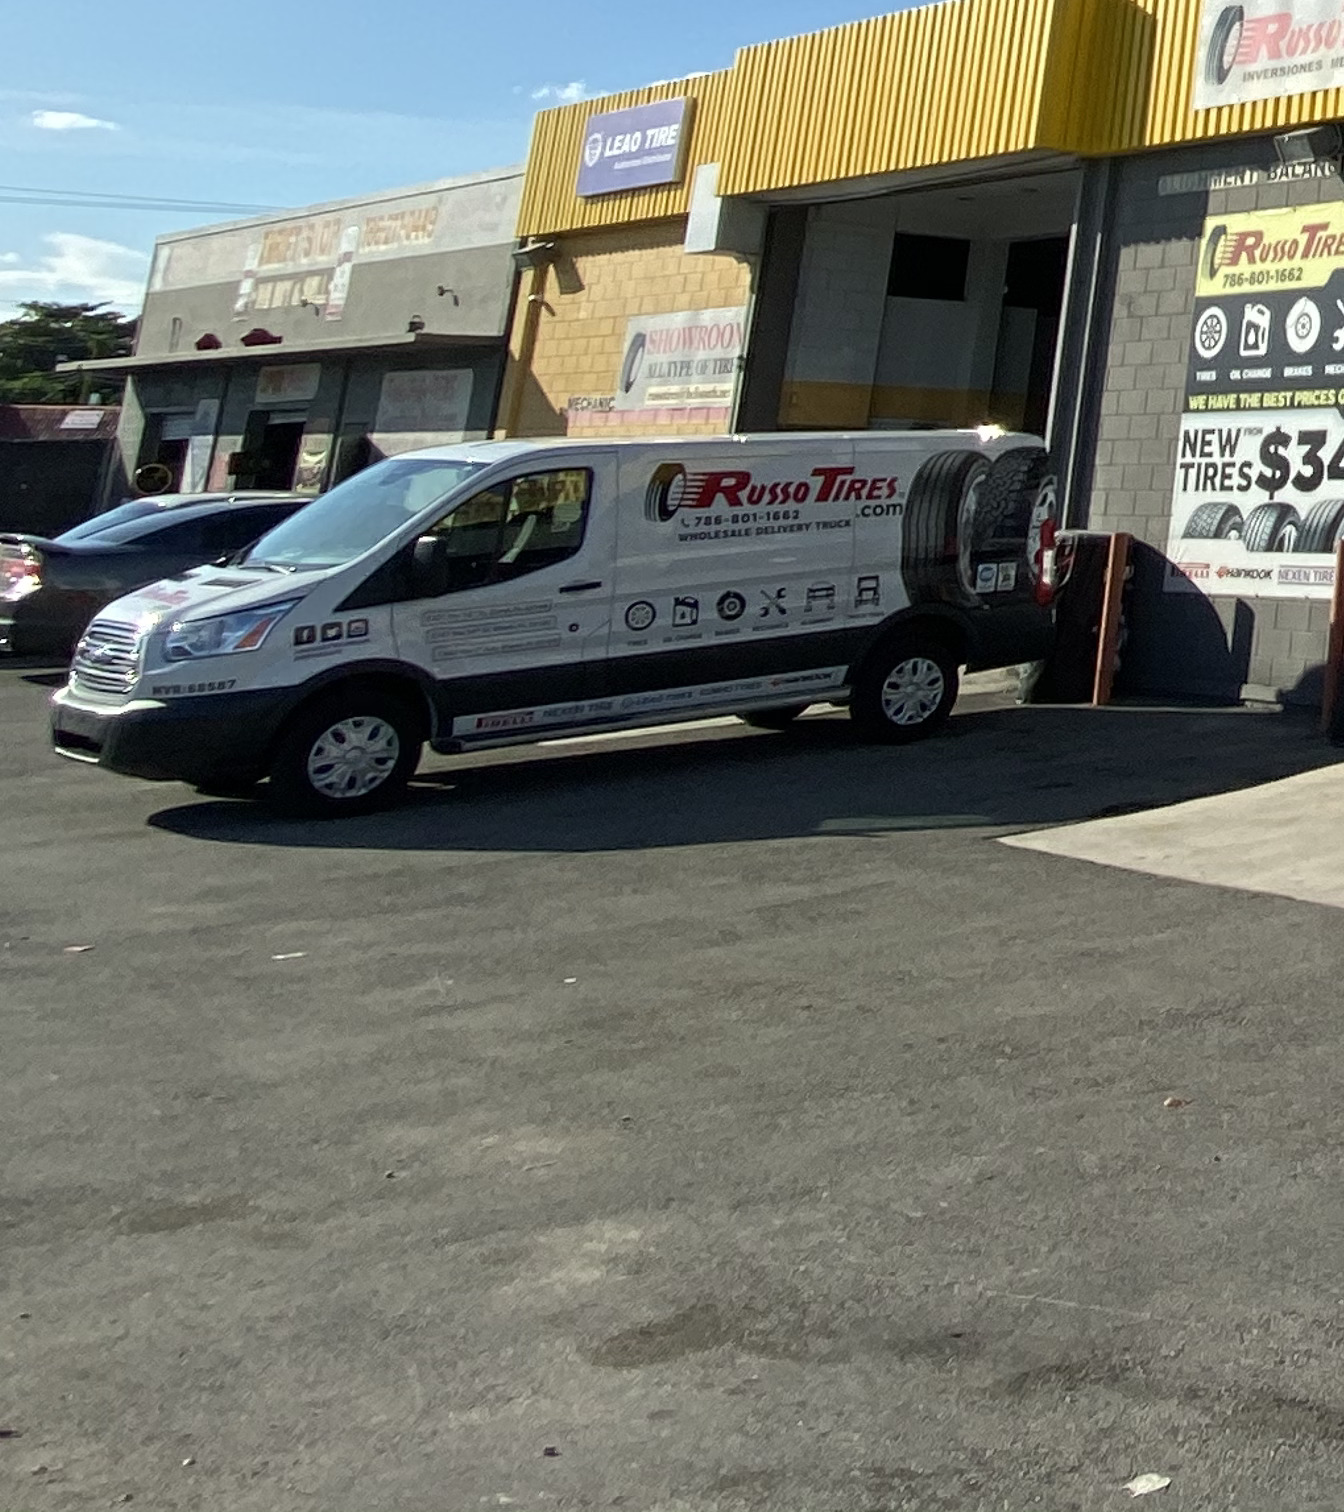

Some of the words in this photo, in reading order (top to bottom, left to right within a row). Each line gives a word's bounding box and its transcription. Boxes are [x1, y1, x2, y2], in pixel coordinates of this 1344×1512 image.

[1242, 59, 1323, 83] INVERSIONES
[604, 131, 642, 158] LEAO
[645, 123, 679, 149] TIRE
[1222, 266, 1303, 288] 786-801-1662
[666, 360, 693, 377] TYPE
[695, 359, 709, 375] OF
[568, 395, 617, 412] MECHANIC
[1188, 395, 1207, 410] WE
[1208, 394, 1237, 409] HAVE
[1239, 392, 1261, 408] THE
[1263, 390, 1293, 407] BEST
[1294, 389, 1336, 406] PRICES
[1181, 428, 1242, 459] NEW
[811, 466, 898, 503] TIRES
[1179, 461, 1254, 493] TIRES
[678, 527, 751, 543] WHOLESALE
[755, 521, 811, 536] DELIVERY
[815, 518, 852, 531] TRUCK
[1278, 567, 1311, 583] NEXEN
